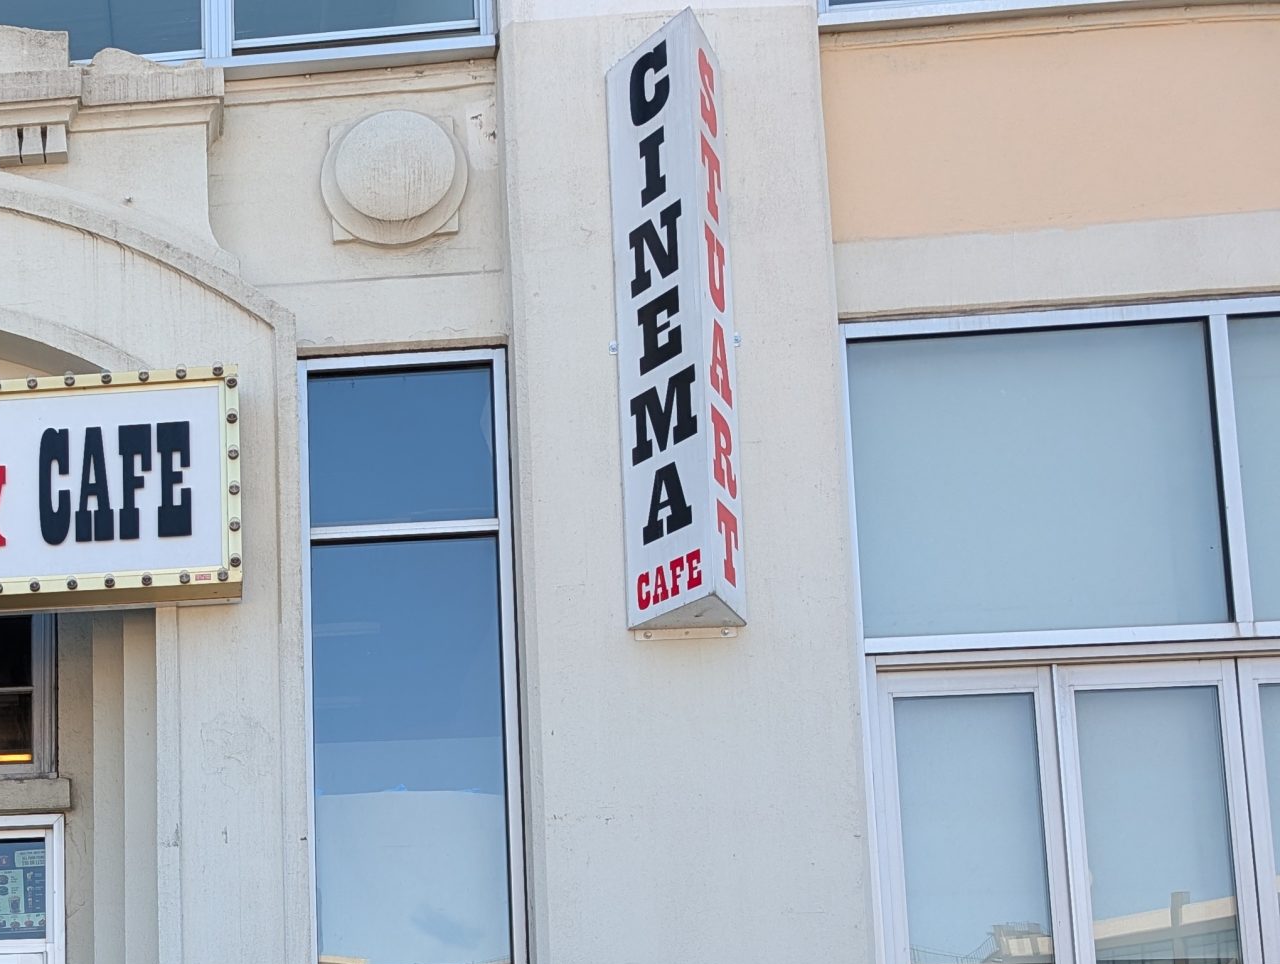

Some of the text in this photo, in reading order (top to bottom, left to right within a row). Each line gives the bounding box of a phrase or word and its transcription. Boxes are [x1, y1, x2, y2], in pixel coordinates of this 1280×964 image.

[629, 38, 698, 546] CINEMA
[697, 47, 738, 588] STUART
[38, 420, 192, 546] CAFE
[636, 548, 702, 611] CAFE
